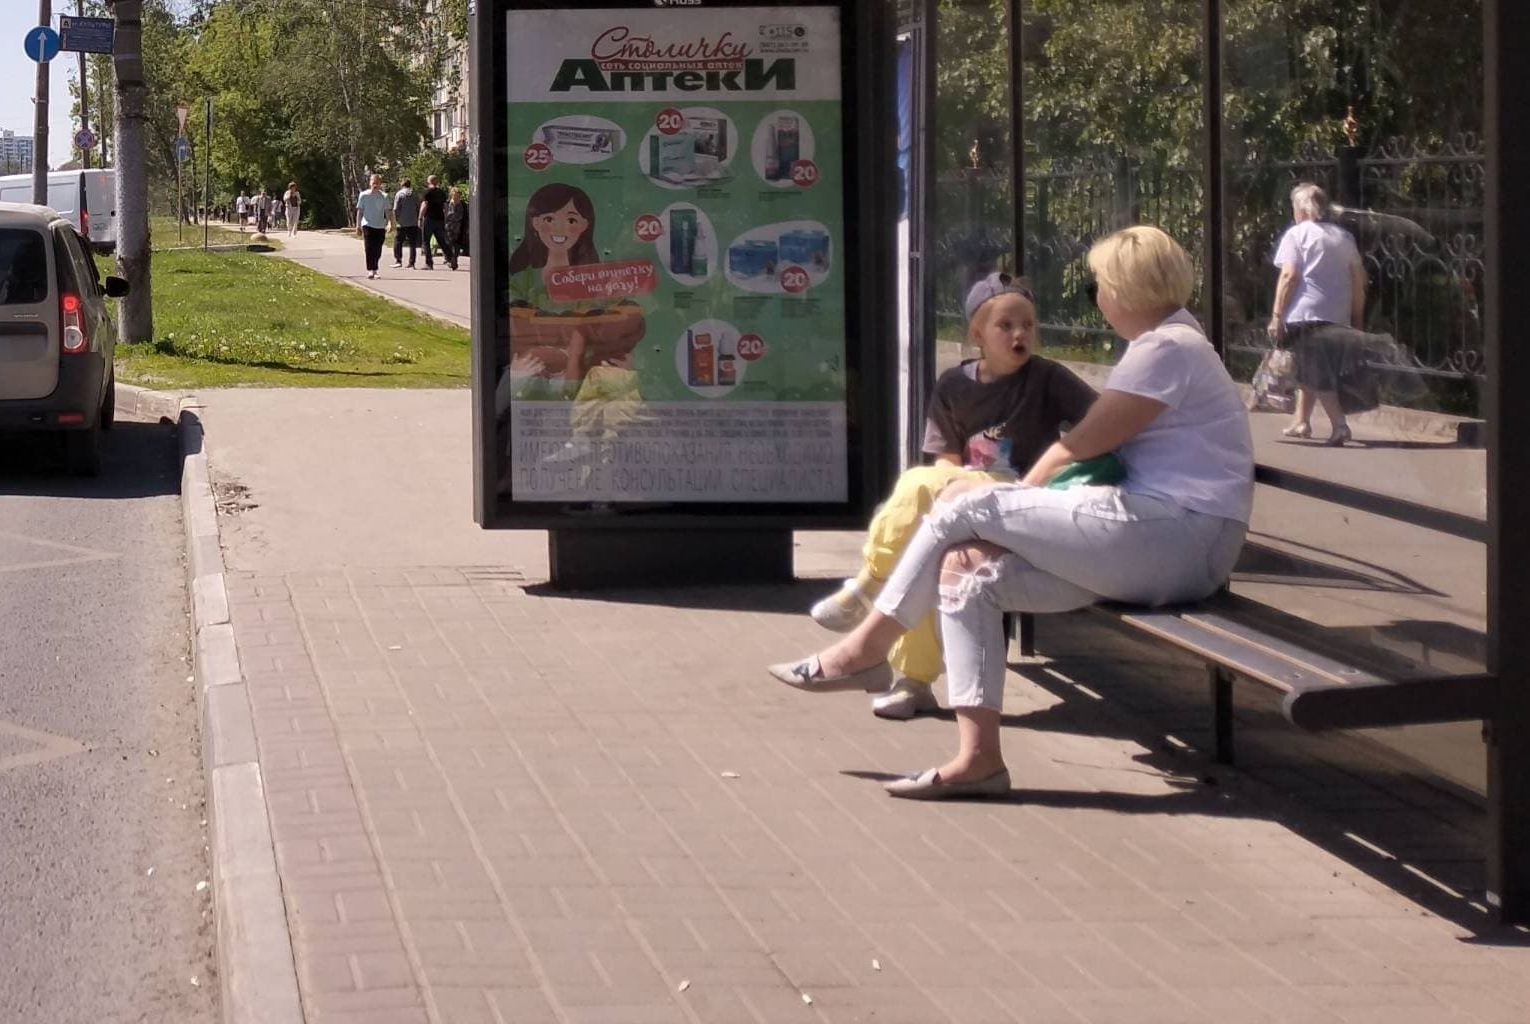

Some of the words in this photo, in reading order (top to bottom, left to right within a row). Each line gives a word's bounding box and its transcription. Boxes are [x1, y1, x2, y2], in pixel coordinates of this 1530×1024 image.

[591, 26, 754, 60] Столички
[600, 61, 625, 71] сеть
[628, 61, 705, 72] социальных
[706, 61, 744, 71] аптек
[550, 270, 596, 286] Собери
[597, 263, 654, 278] аптечку
[587, 283, 603, 293] на
[605, 275, 639, 296] дачу!
